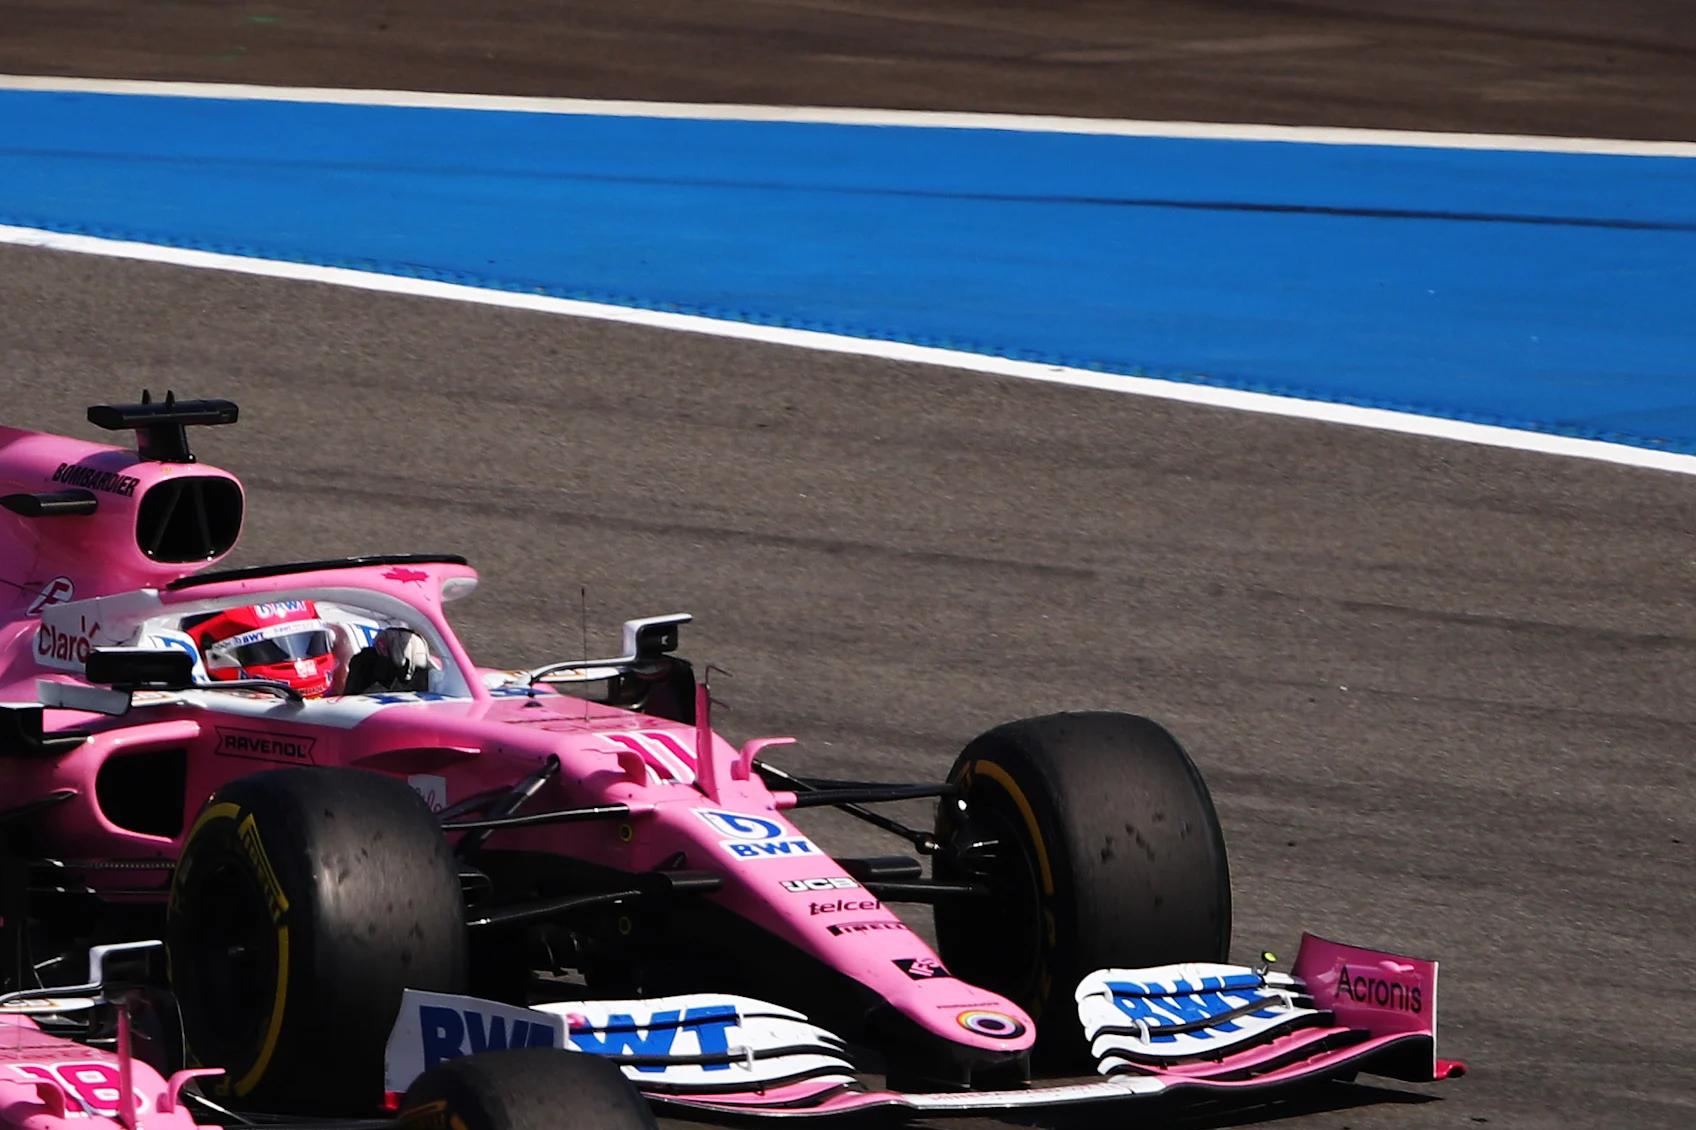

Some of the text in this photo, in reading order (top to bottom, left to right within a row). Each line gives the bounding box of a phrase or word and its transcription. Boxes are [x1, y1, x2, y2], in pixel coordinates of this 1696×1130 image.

[52, 462, 140, 497] BOMBARDIER
[37, 616, 100, 663] Claro
[224, 734, 306, 759] RAVENOL
[728, 840, 813, 857] BWT
[780, 877, 860, 893] JCB
[809, 900, 881, 915] telcel
[1335, 964, 1423, 1014] Acronis
